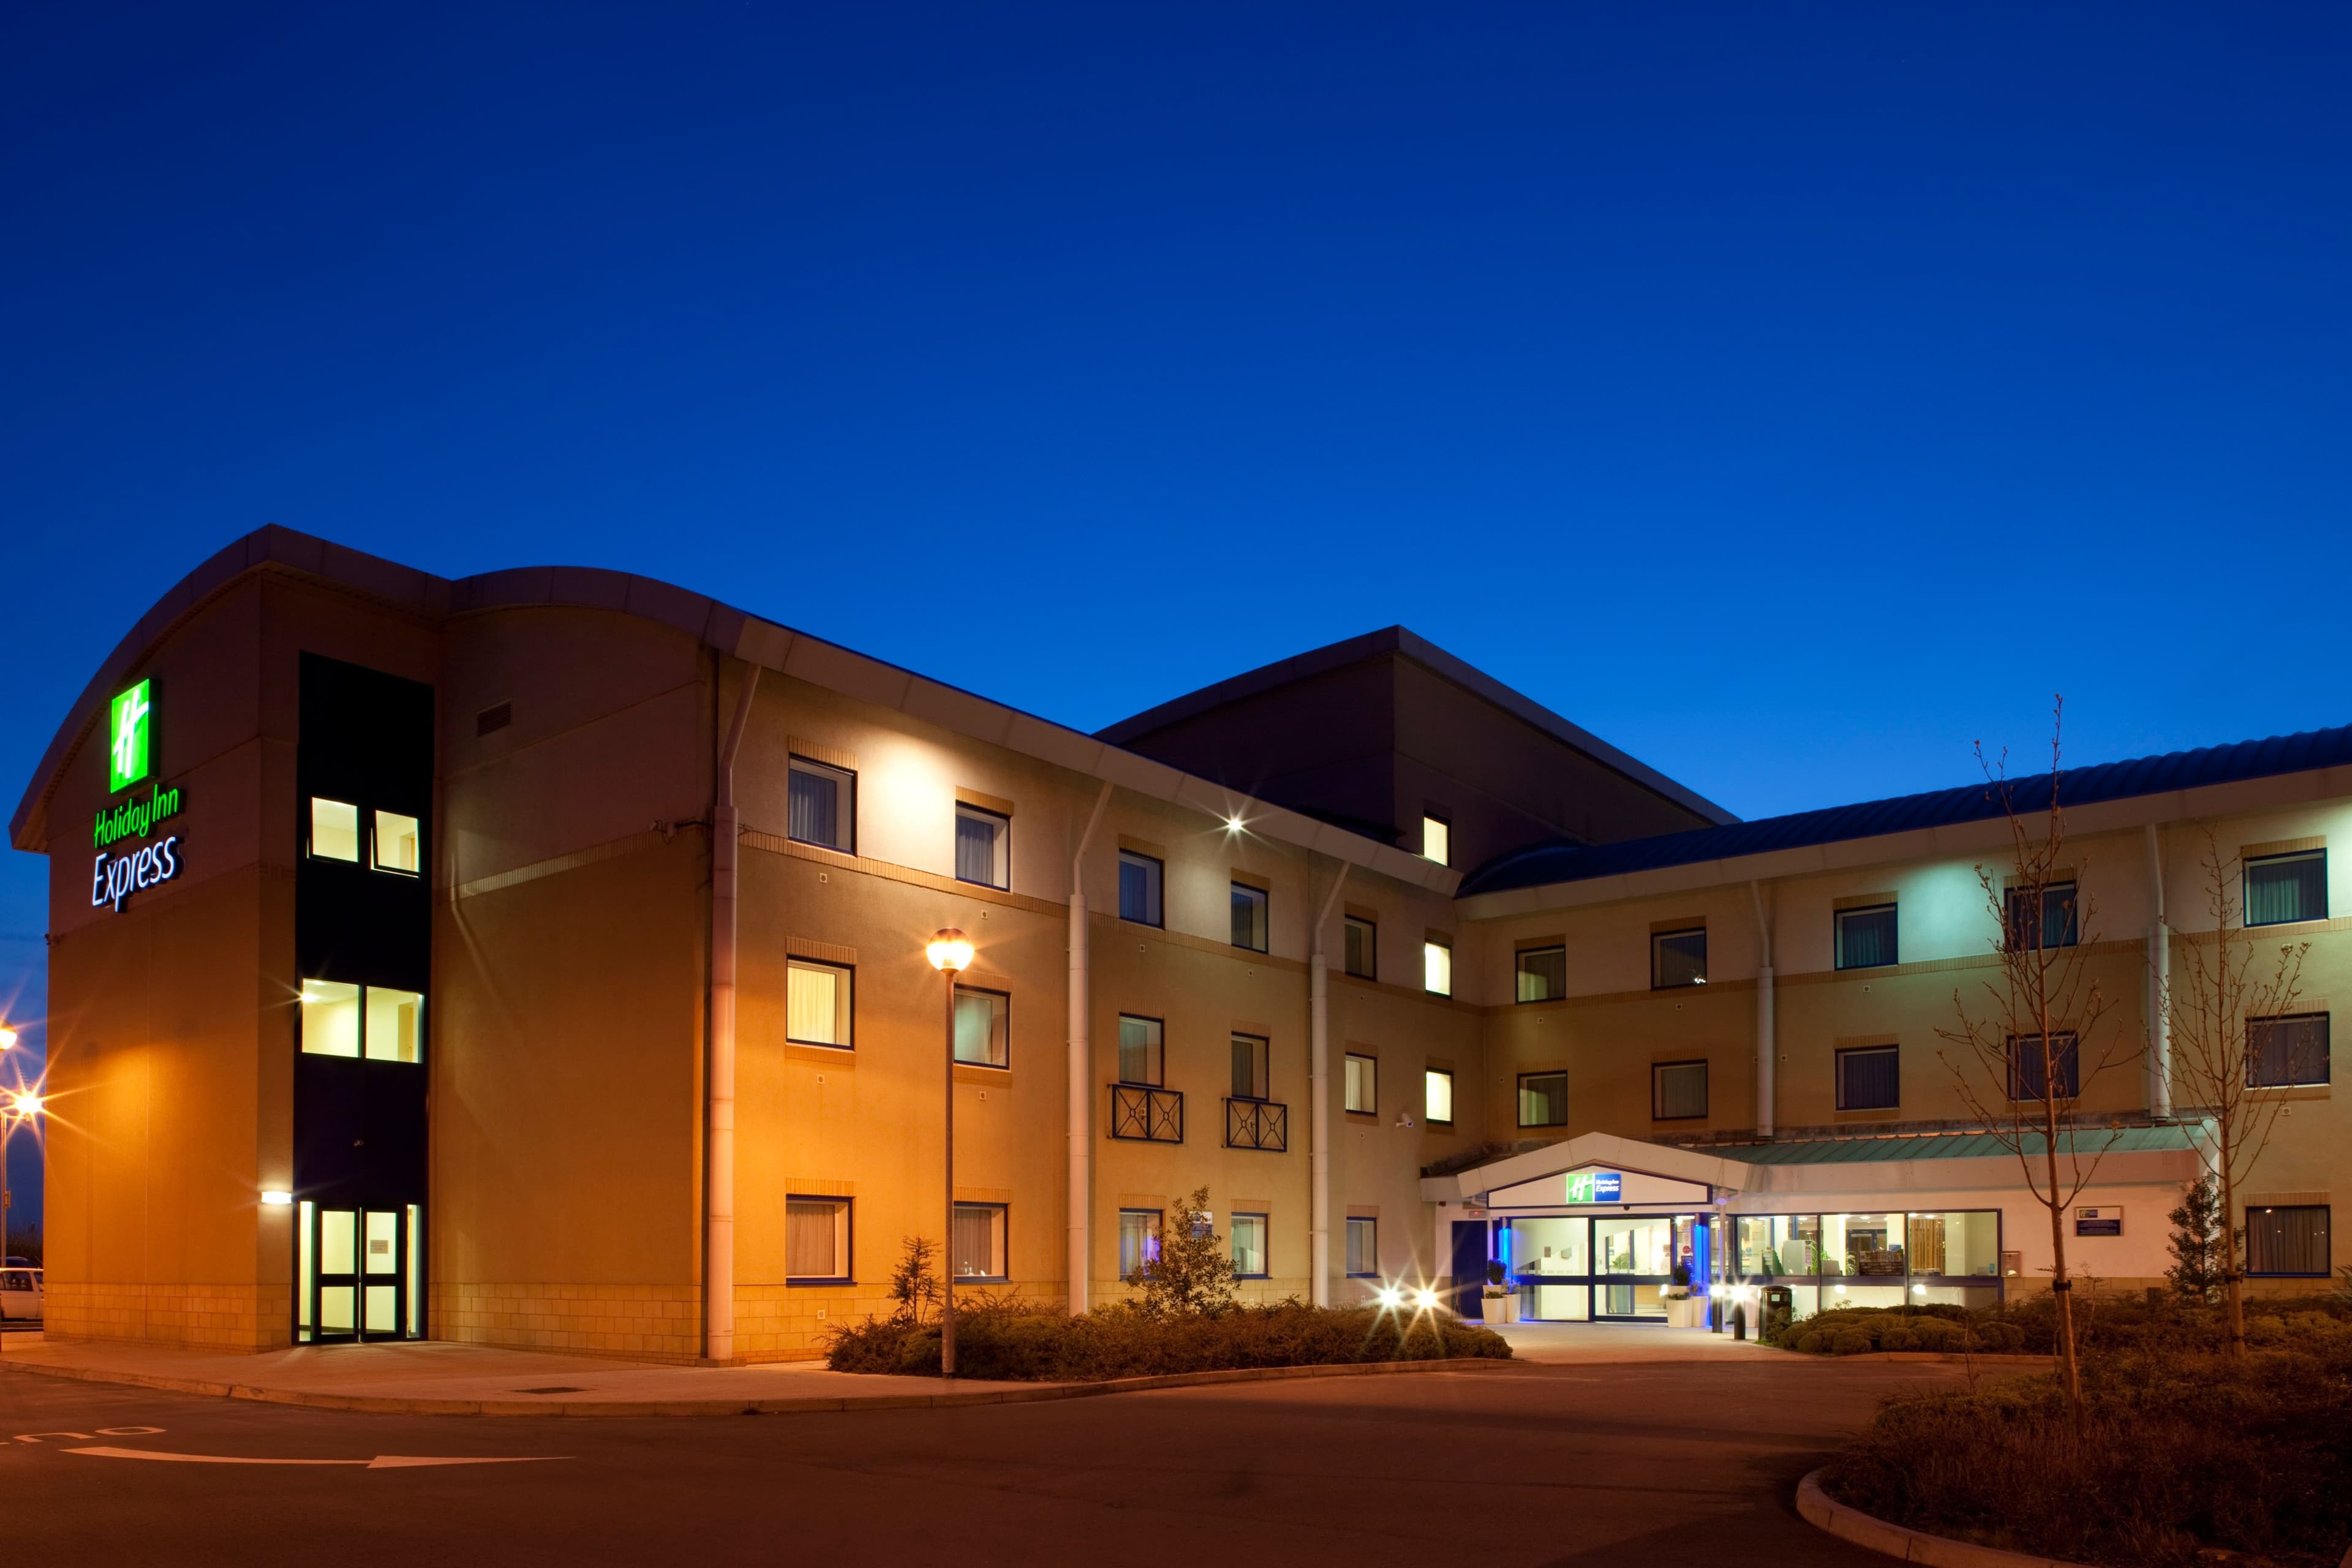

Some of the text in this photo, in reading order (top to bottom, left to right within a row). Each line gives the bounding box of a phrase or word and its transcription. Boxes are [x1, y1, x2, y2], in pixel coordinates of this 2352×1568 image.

[94, 784, 178, 848] Holiday Inn
[92, 837, 176, 912] Express
